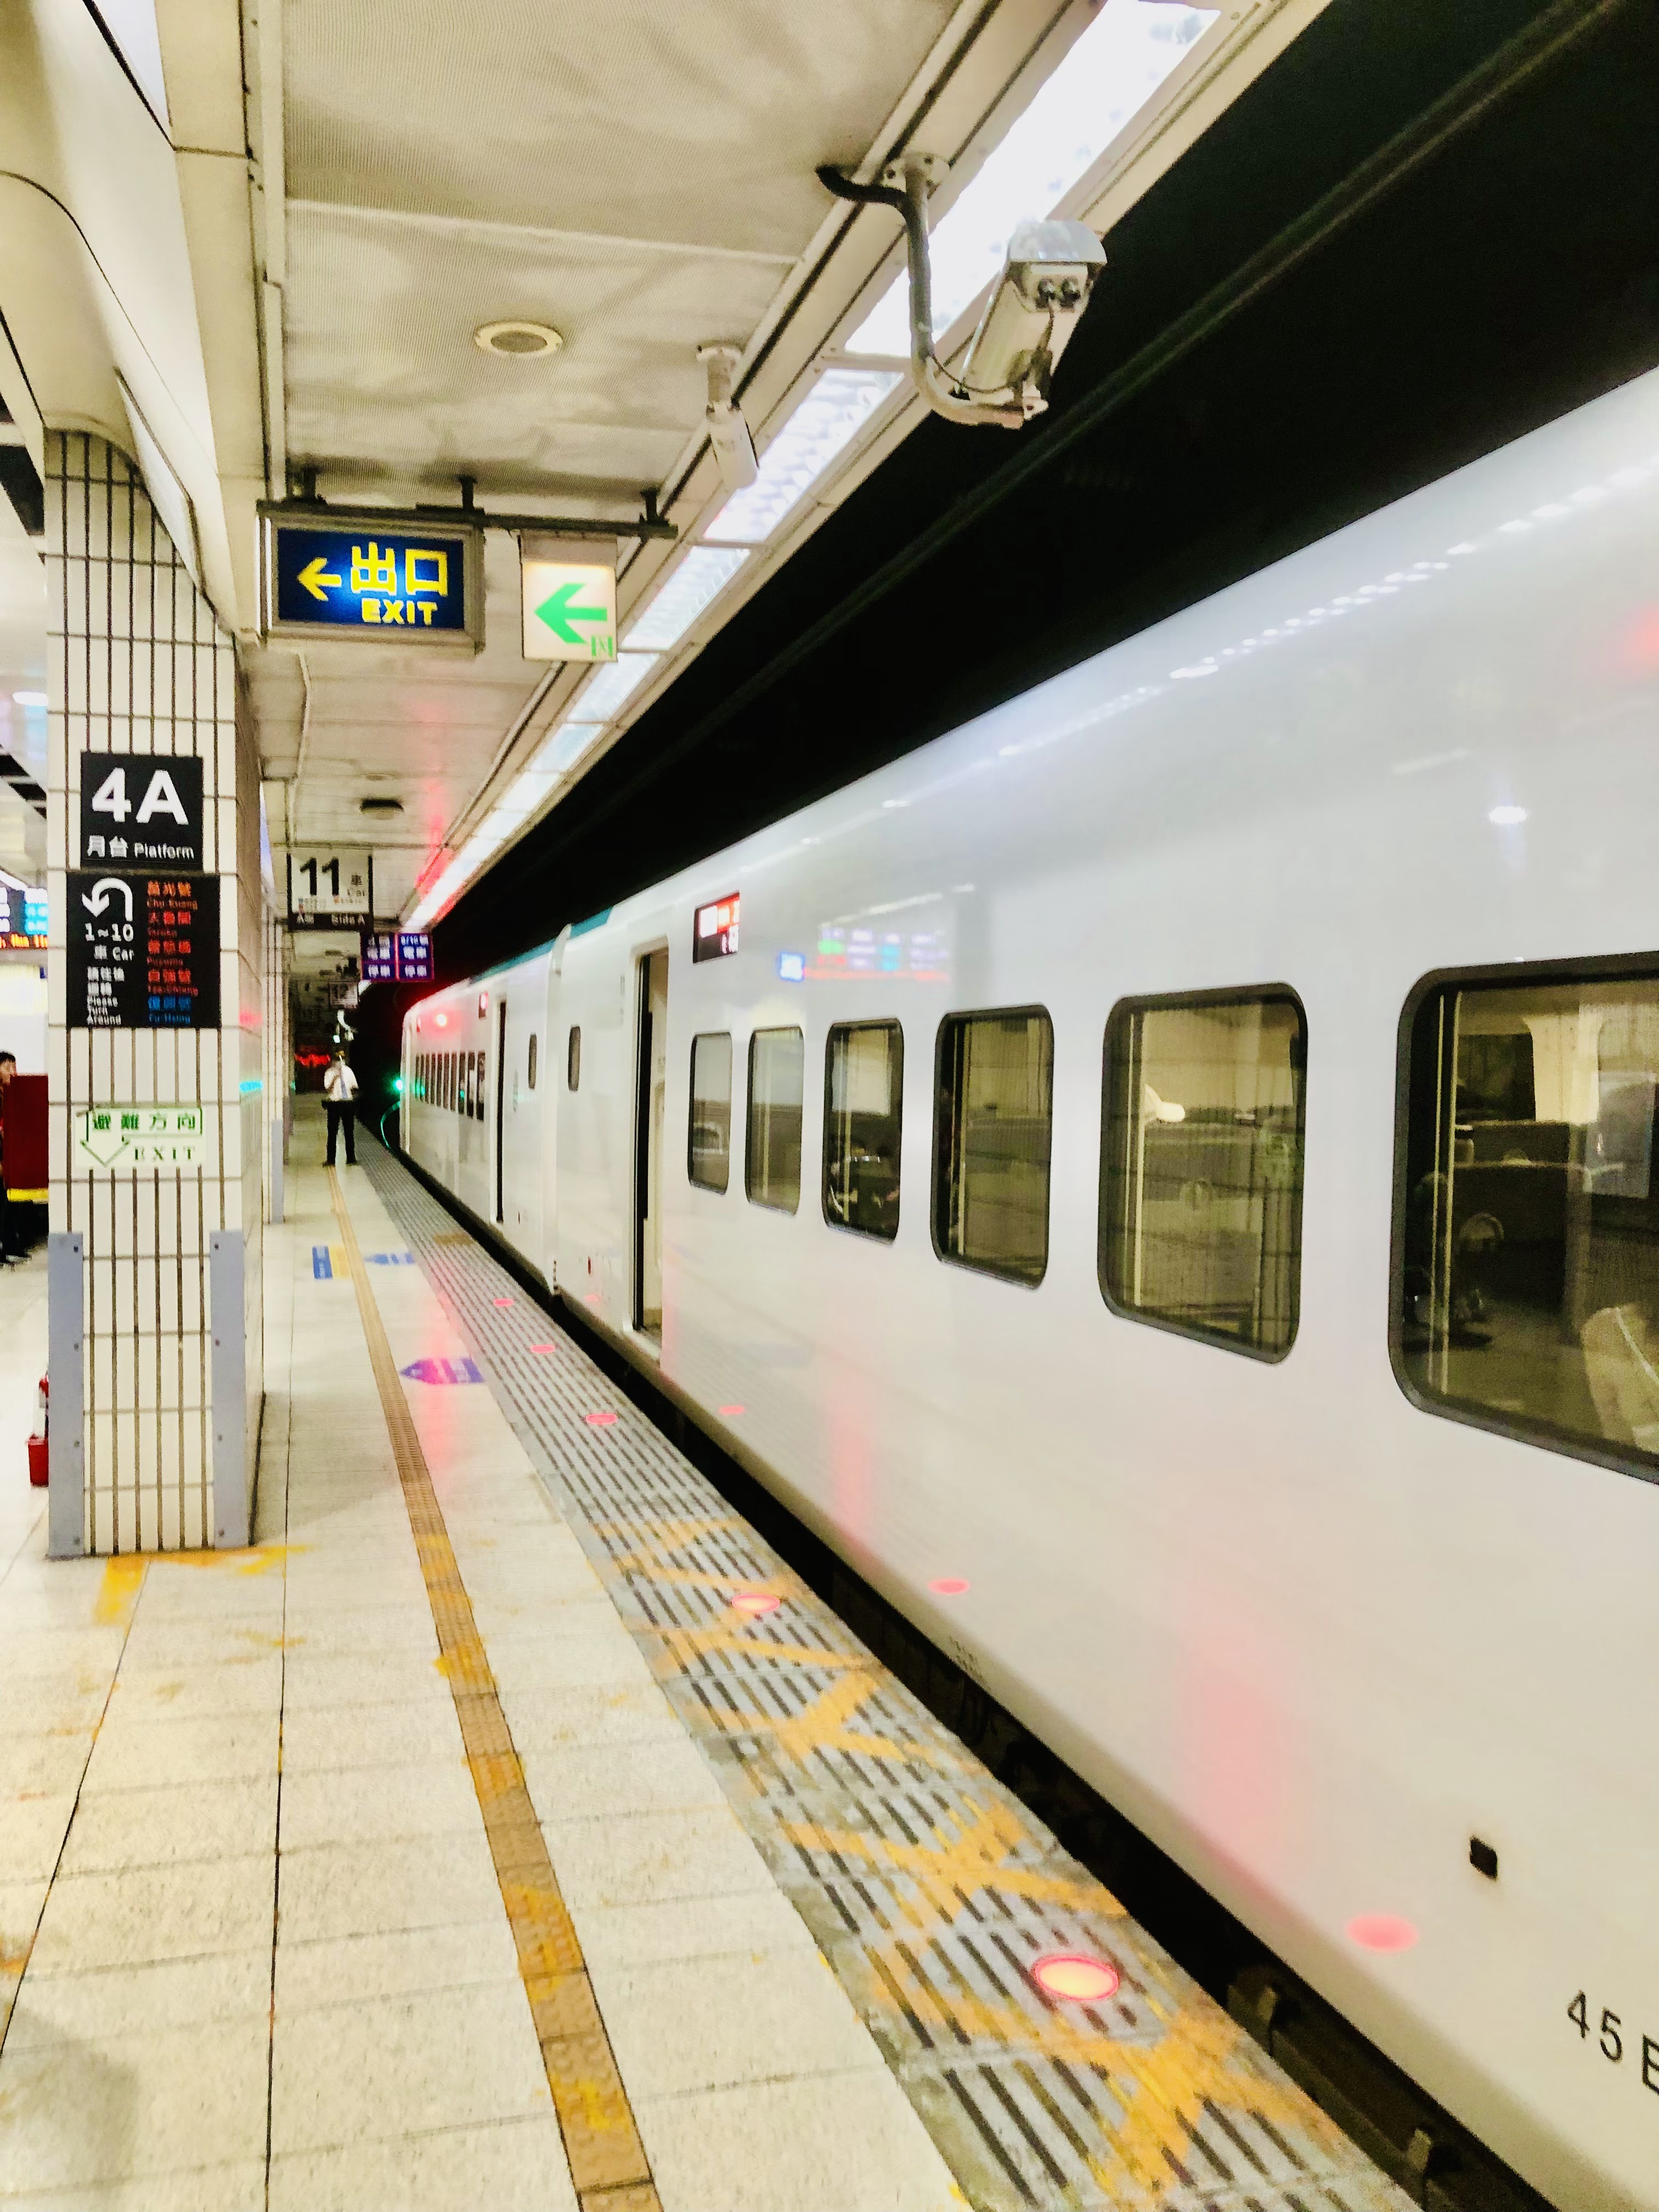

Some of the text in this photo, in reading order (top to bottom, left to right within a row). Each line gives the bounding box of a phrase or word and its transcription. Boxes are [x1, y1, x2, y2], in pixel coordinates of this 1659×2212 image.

[351, 541, 448, 597] 出口
[362, 599, 438, 625] EXIT
[92, 768, 189, 825] 4A
[87, 834, 194, 859] 月台 Platform
[300, 857, 339, 896] 11
[351, 874, 362, 887] 車
[92, 1111, 196, 1132] 避難方向
[134, 1146, 196, 1161] EXIT
[1567, 1989, 1623, 2063] 45
